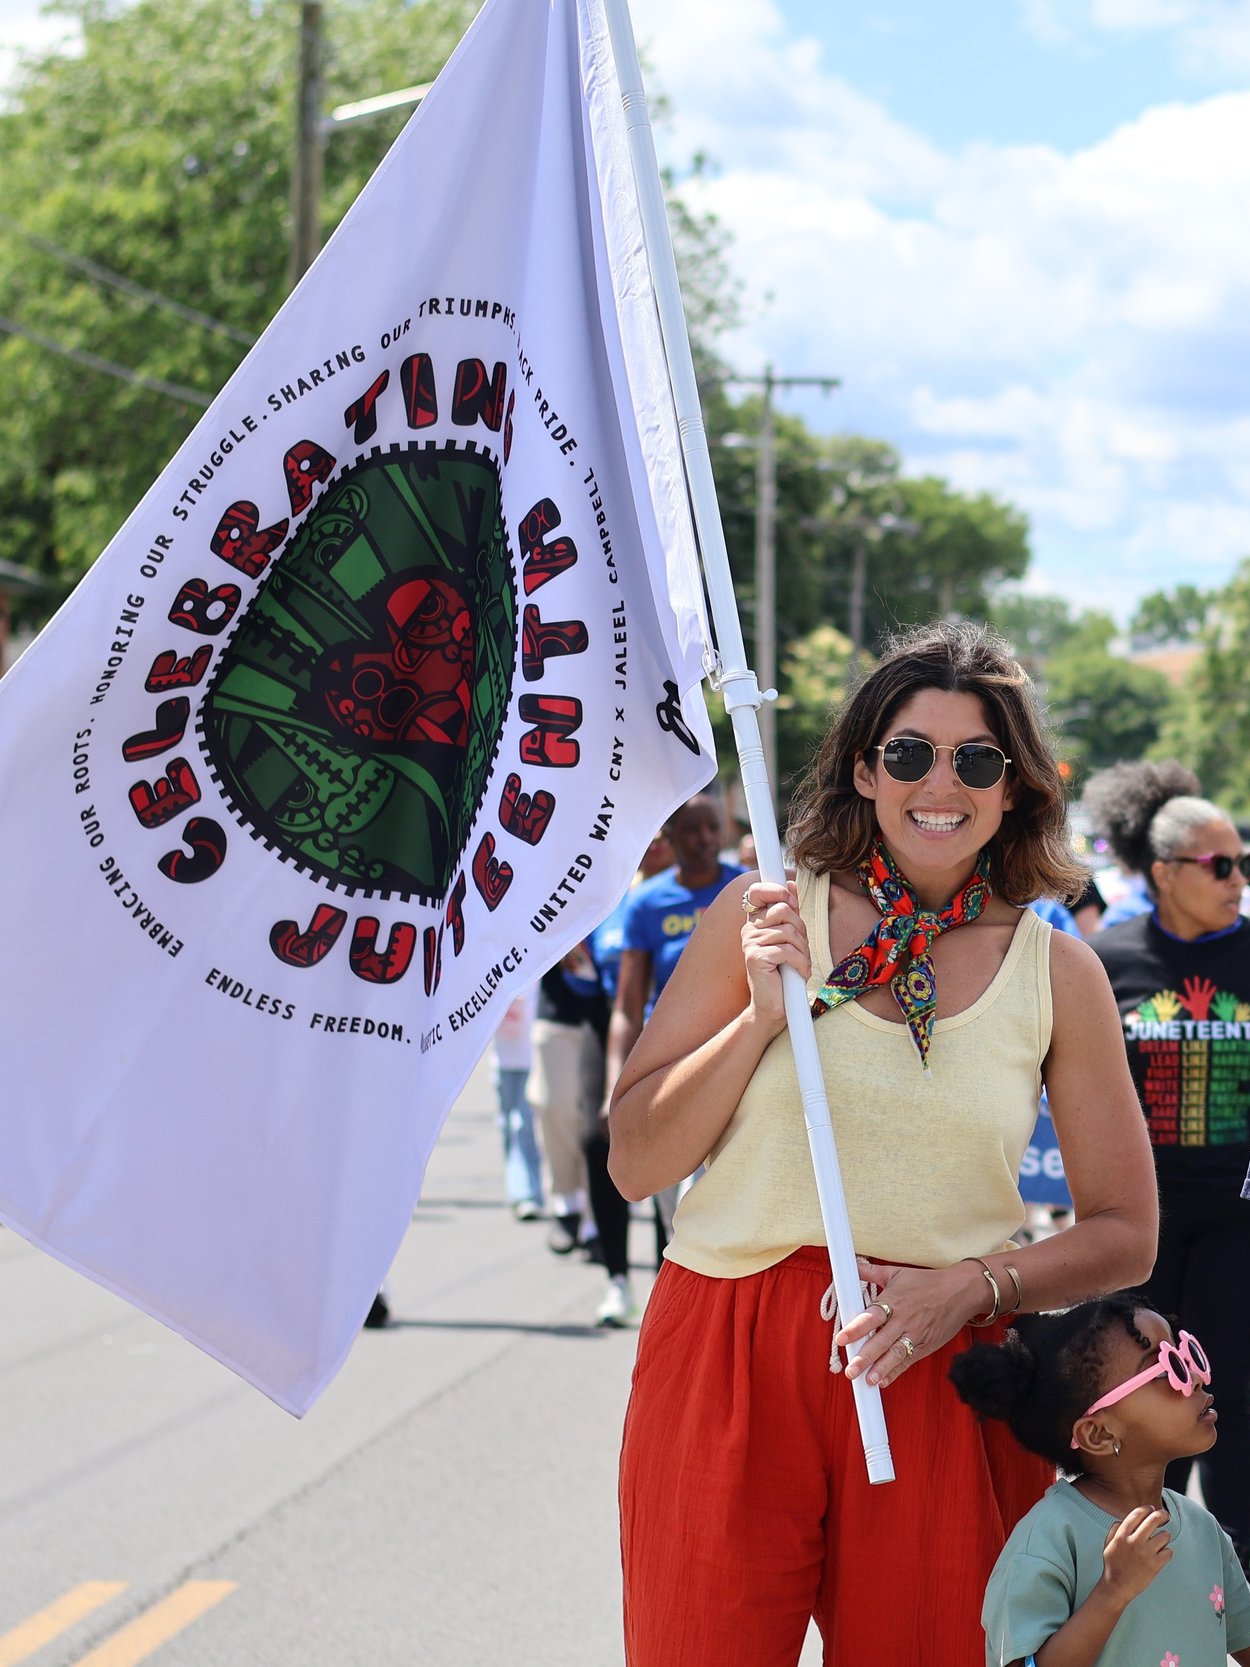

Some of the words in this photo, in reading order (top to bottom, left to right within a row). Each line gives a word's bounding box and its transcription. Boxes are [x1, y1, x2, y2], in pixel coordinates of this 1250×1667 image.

[380, 318, 411, 350] OUR
[418, 297, 516, 335] TRIUMPHS.
[267, 345, 366, 412] SHARING
[534, 388, 578, 467] PRIDE.
[172, 414, 268, 522] STRUGGLE.
[583, 467, 619, 584] CAMPBELL
[139, 534, 174, 579] OUR
[89, 593, 145, 705] HONORING
[611, 600, 628, 691] JALEEL
[72, 716, 94, 795] ROOTS.
[609, 735, 624, 782] CNY
[80, 804, 105, 848] OUR
[588, 795, 615, 842] WAY
[99, 856, 185, 958] EMBRACING
[529, 853, 593, 933] UNITED
[204, 967, 296, 1020] ENDLESS
[447, 946, 528, 1032] EXCELLENCE.
[309, 1012, 411, 1044] FREEDOM.
[1182, 1040, 1208, 1052] LIKE
[1151, 1054, 1179, 1066] LEAD
